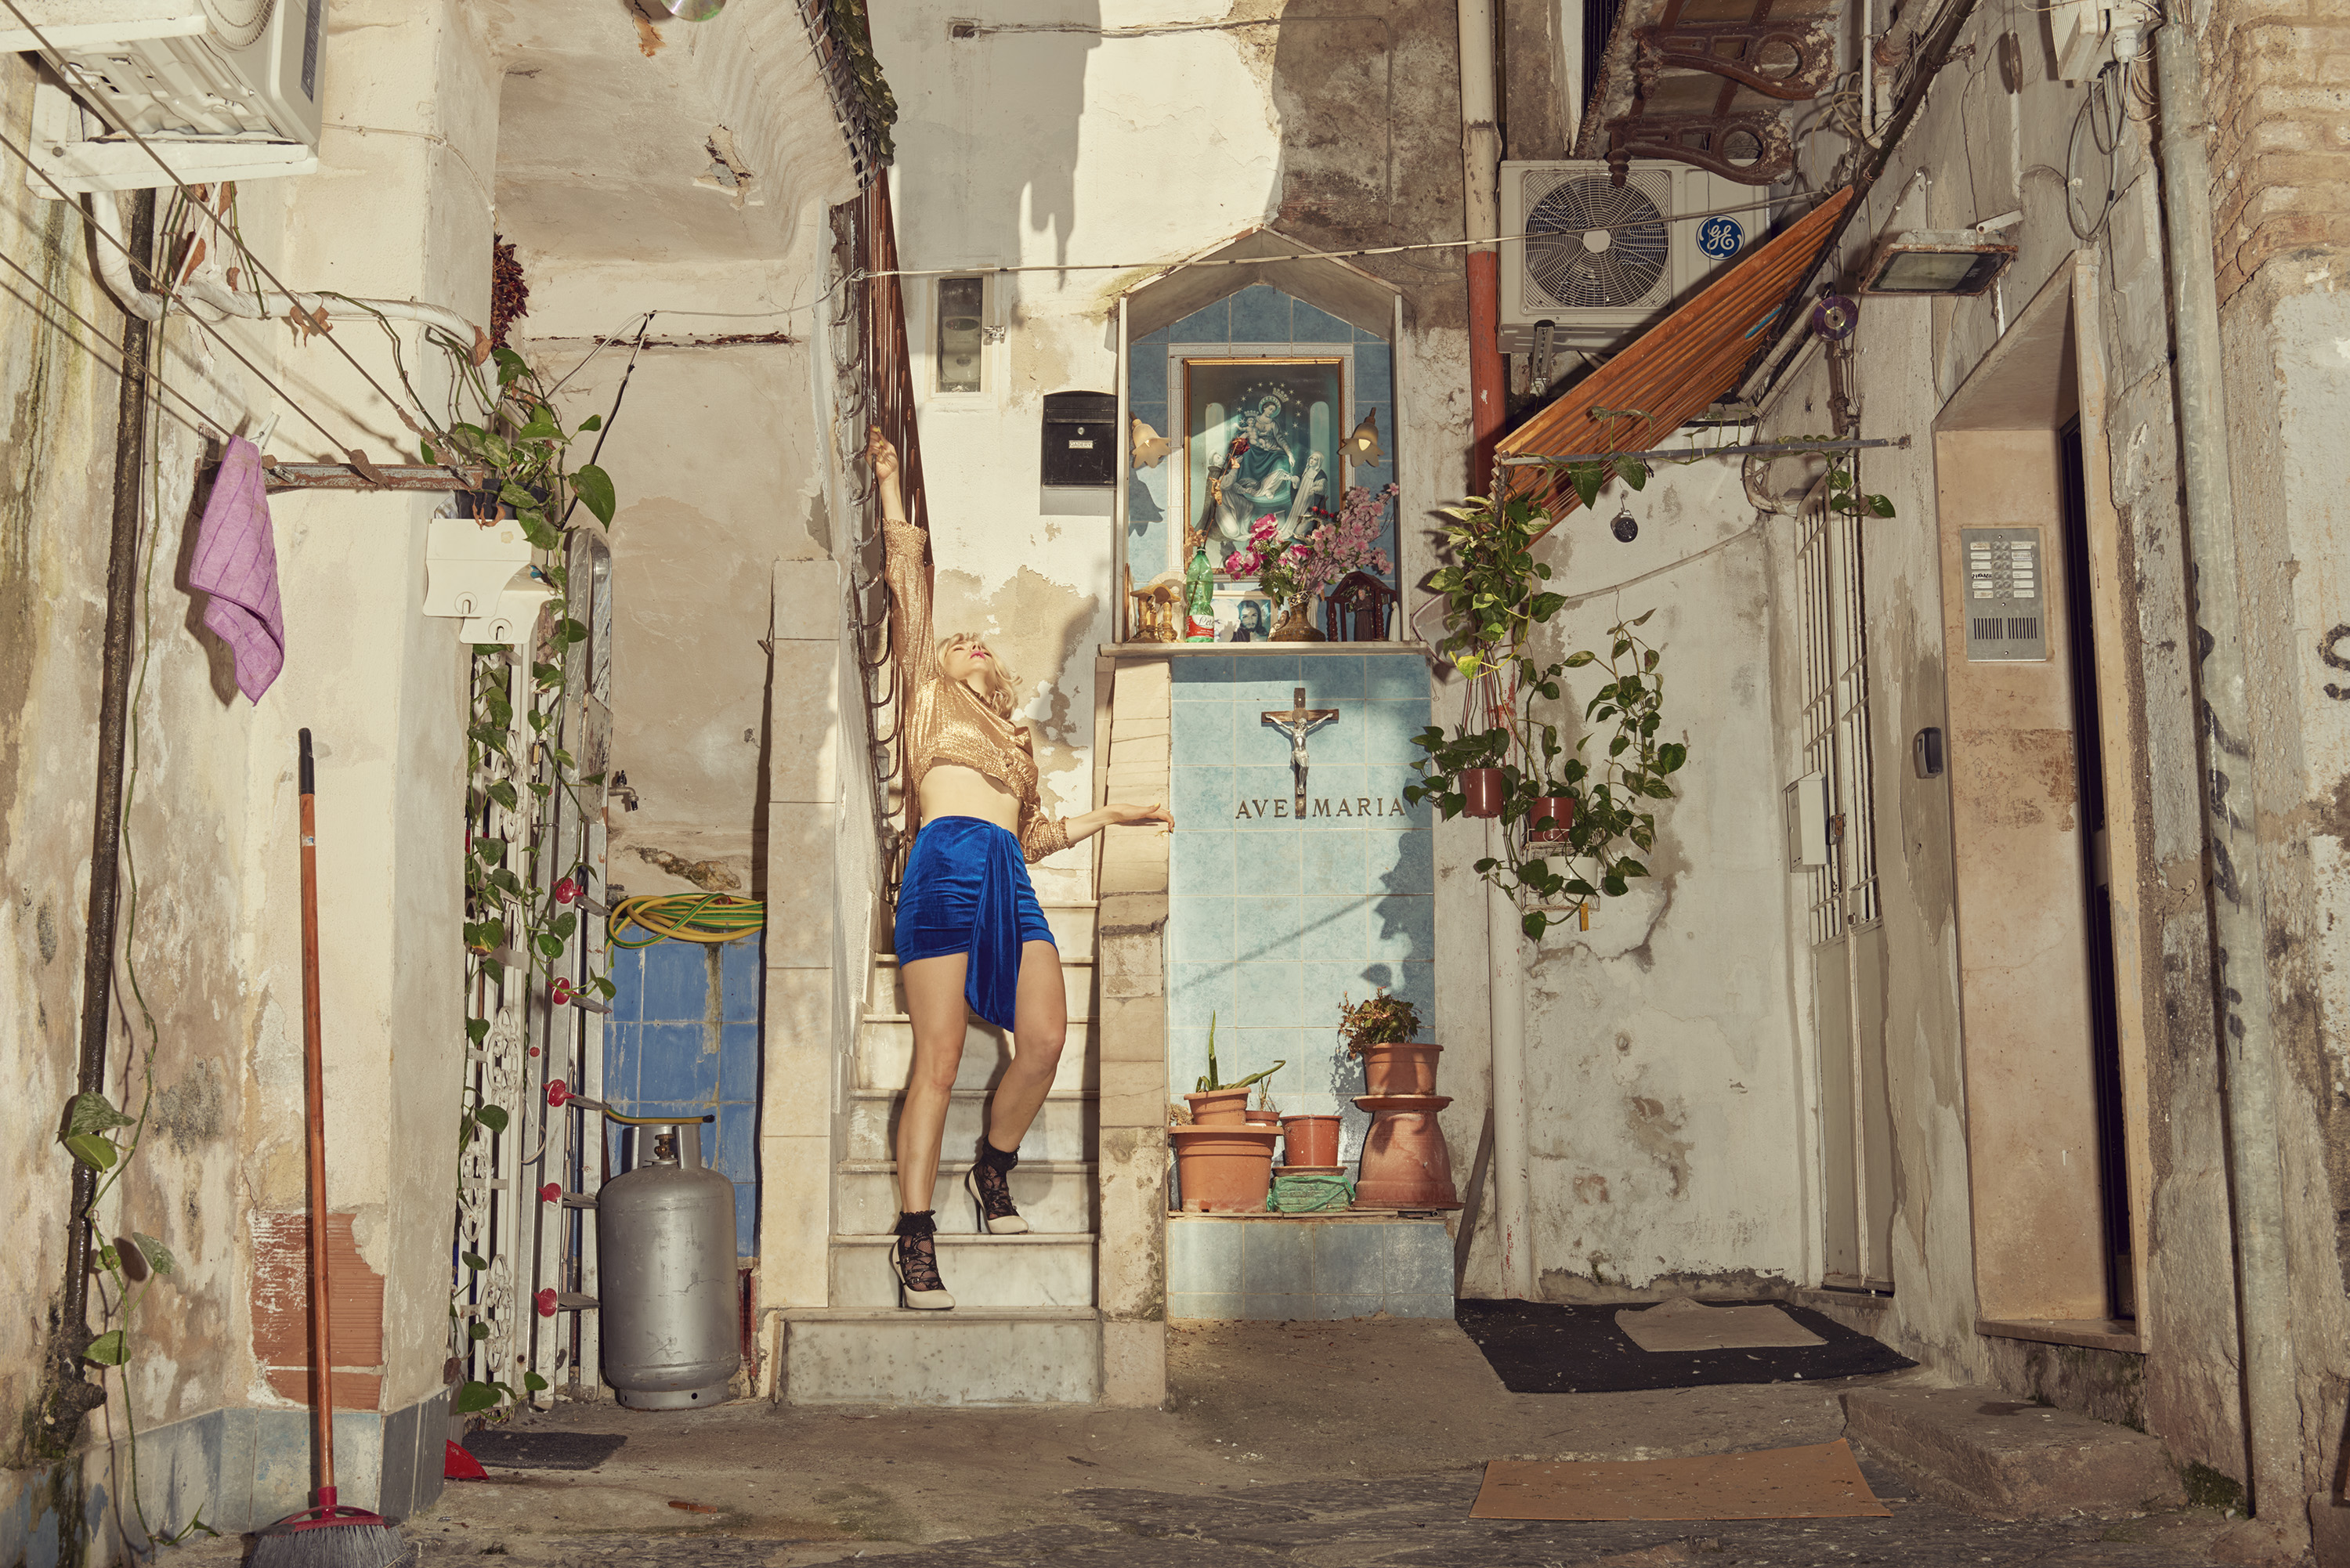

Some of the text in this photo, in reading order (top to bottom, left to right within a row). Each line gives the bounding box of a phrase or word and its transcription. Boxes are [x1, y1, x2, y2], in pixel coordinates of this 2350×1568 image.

[1707, 225, 1734, 250] GE
[1235, 797, 1405, 819] AVE MARIA
